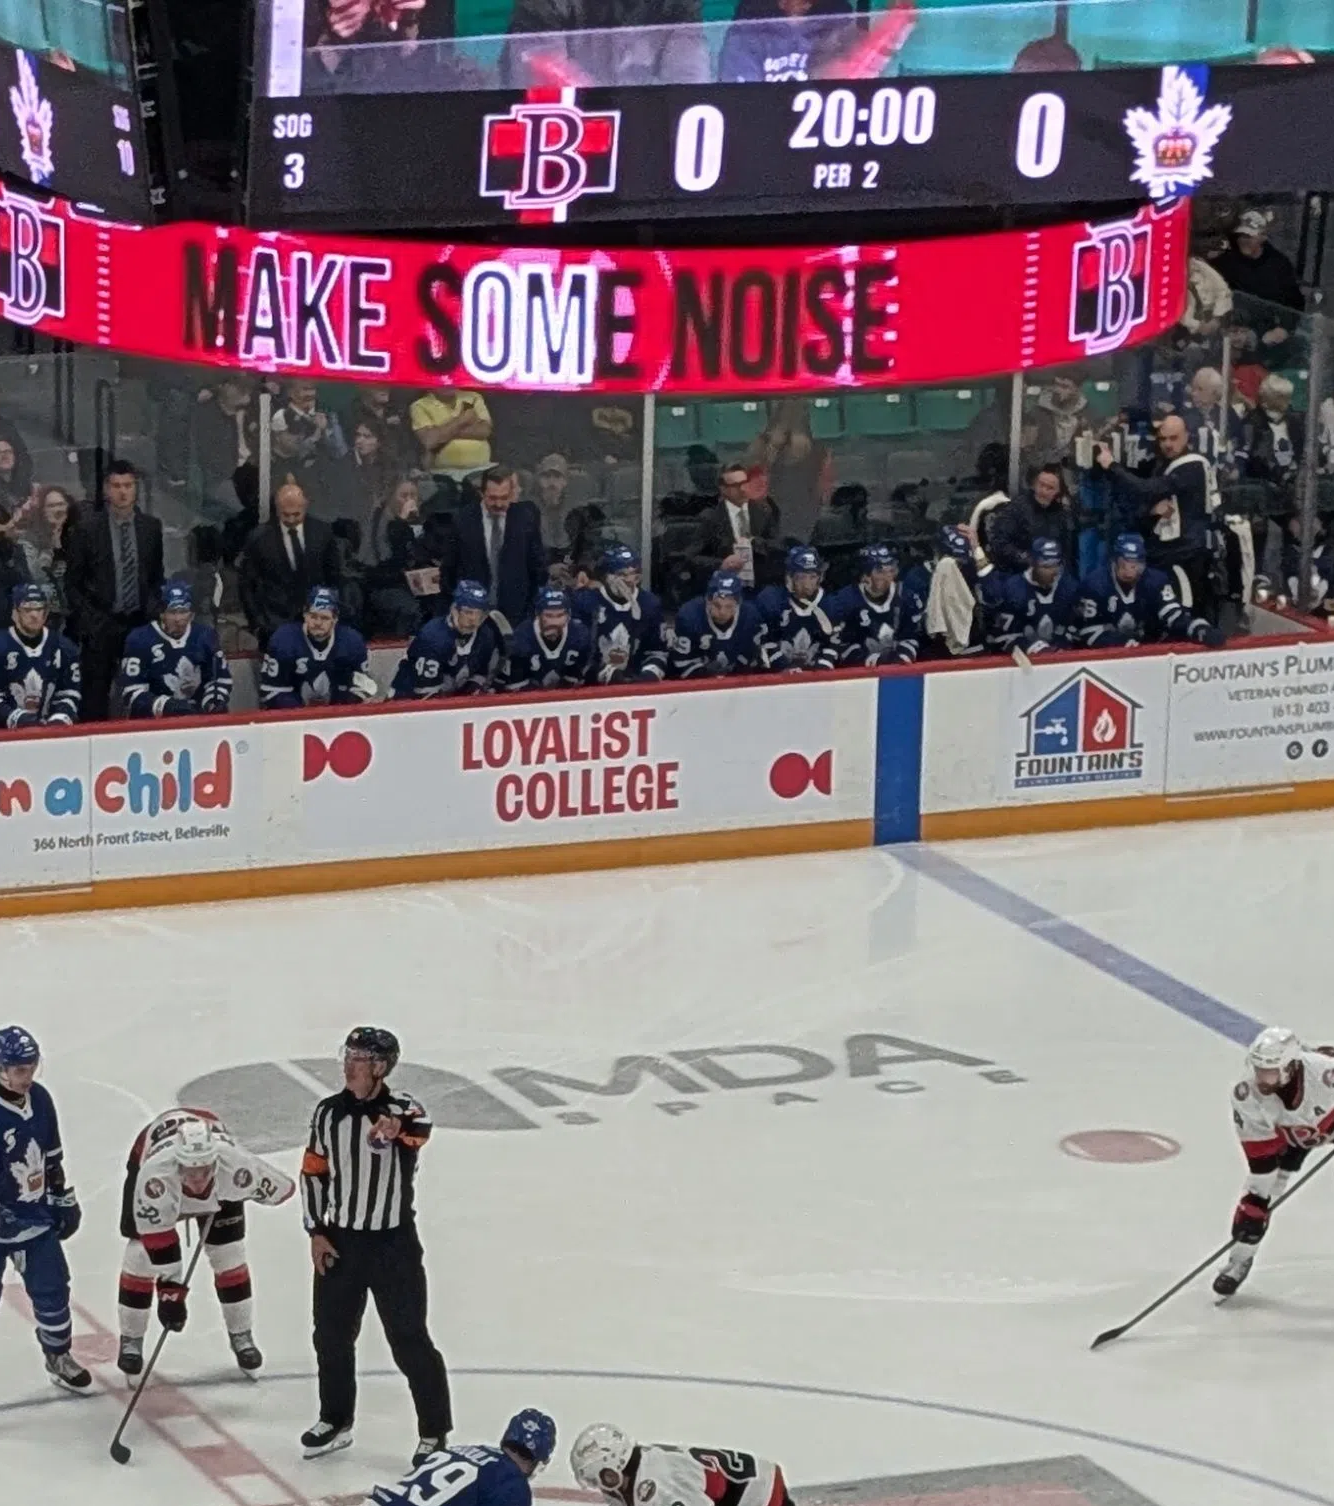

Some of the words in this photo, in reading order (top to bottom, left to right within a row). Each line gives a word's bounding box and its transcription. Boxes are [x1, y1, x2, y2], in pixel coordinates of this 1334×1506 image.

[272, 113, 313, 138] SOG
[789, 87, 936, 148] 20:00
[1015, 93, 1066, 179] 0
[283, 153, 305, 190] 3
[674, 105, 724, 192] 0
[813, 164, 852, 189] PER
[862, 161, 879, 188] 2
[182, 241, 392, 375] MAKE
[416, 261, 643, 386] SOME
[671, 258, 894, 382] NOISE
[1173, 660, 1279, 684] FOUNTAIN'S
[1283, 684, 1327, 697] OWNED
[44, 776, 83, 816] a
[94, 740, 233, 818] child
[1015, 750, 1144, 777] FOUNTAIN'S
[495, 761, 678, 822] COLLEGE
[58, 833, 93, 849] North
[97, 831, 129, 846] Front
[175, 824, 230, 840] Belleville
[494, 1033, 999, 1106] MDA
